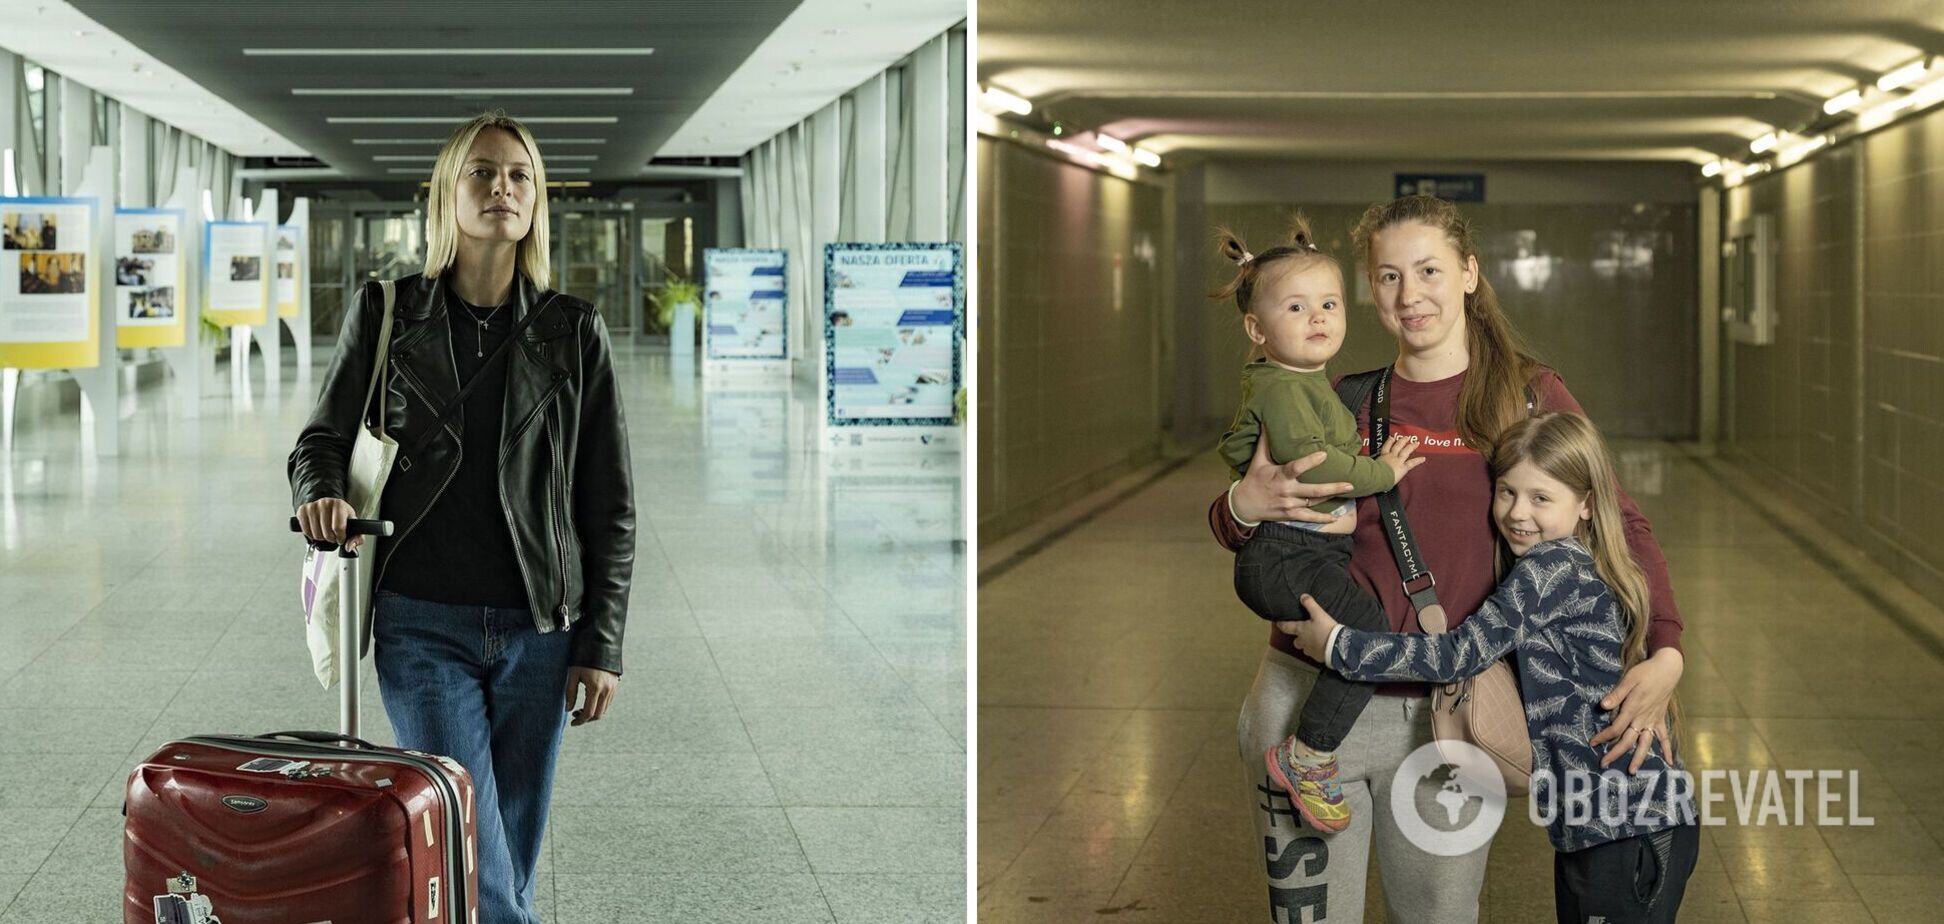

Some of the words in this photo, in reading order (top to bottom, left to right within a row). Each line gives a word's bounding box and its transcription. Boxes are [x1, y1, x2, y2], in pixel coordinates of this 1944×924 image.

[842, 255, 880, 266] NASZA
[885, 255, 929, 266] OFERTA
[1424, 435, 1451, 447] love
